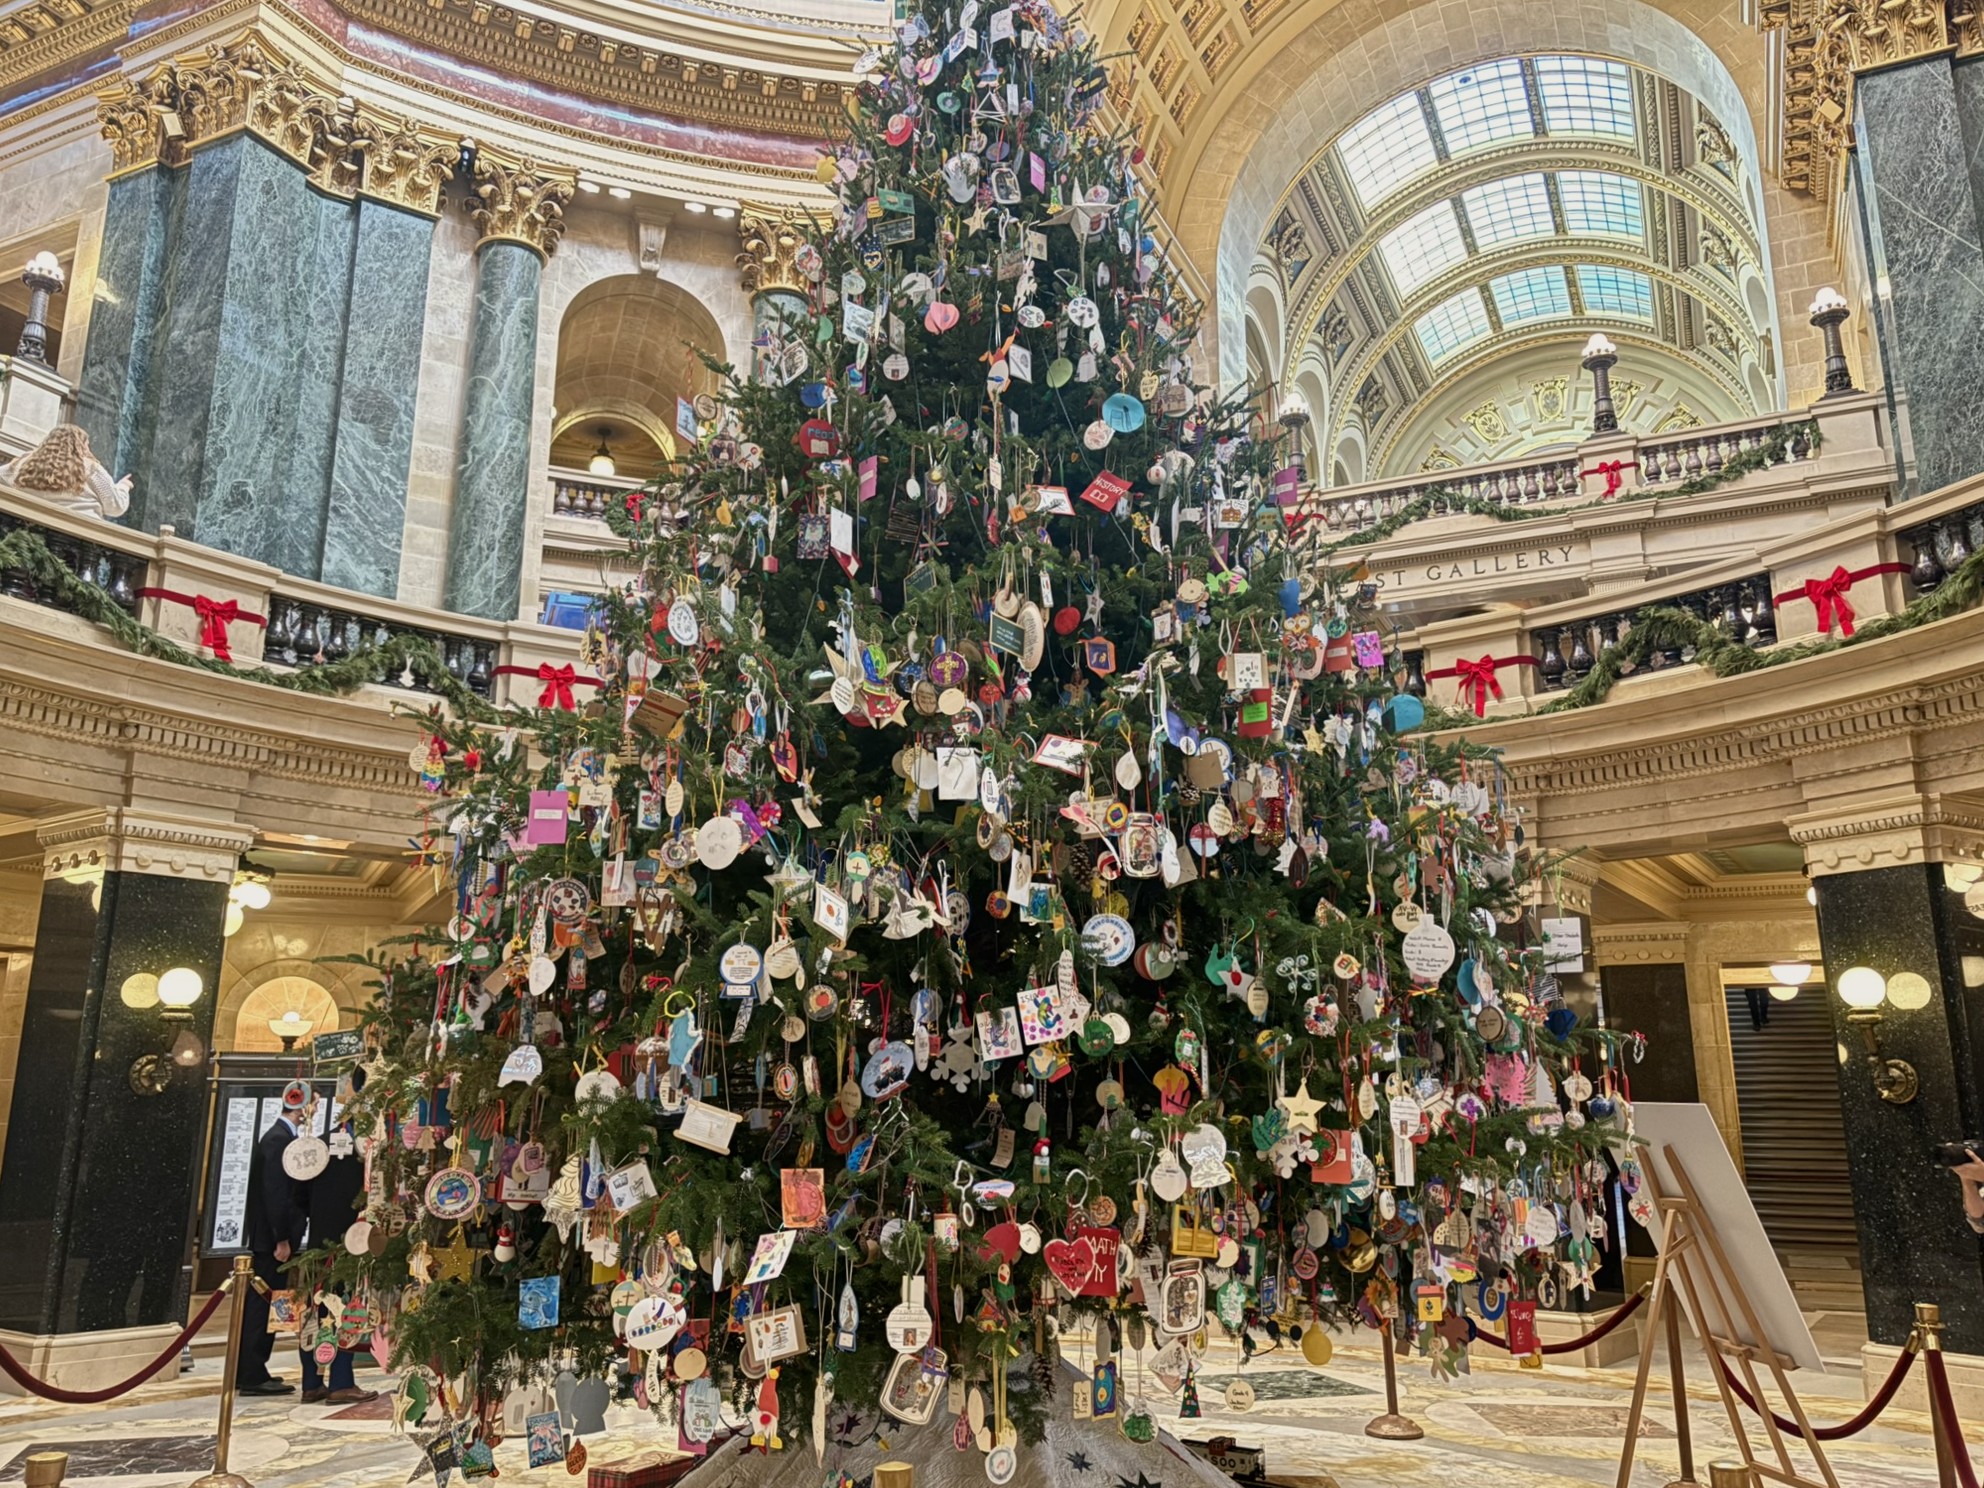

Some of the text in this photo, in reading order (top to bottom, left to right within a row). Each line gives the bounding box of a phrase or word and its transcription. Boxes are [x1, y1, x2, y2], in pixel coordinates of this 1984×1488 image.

[807, 427, 835, 440] read
[1426, 546, 1573, 581] GALLERY
[1210, 1456, 1237, 1469] SOO
